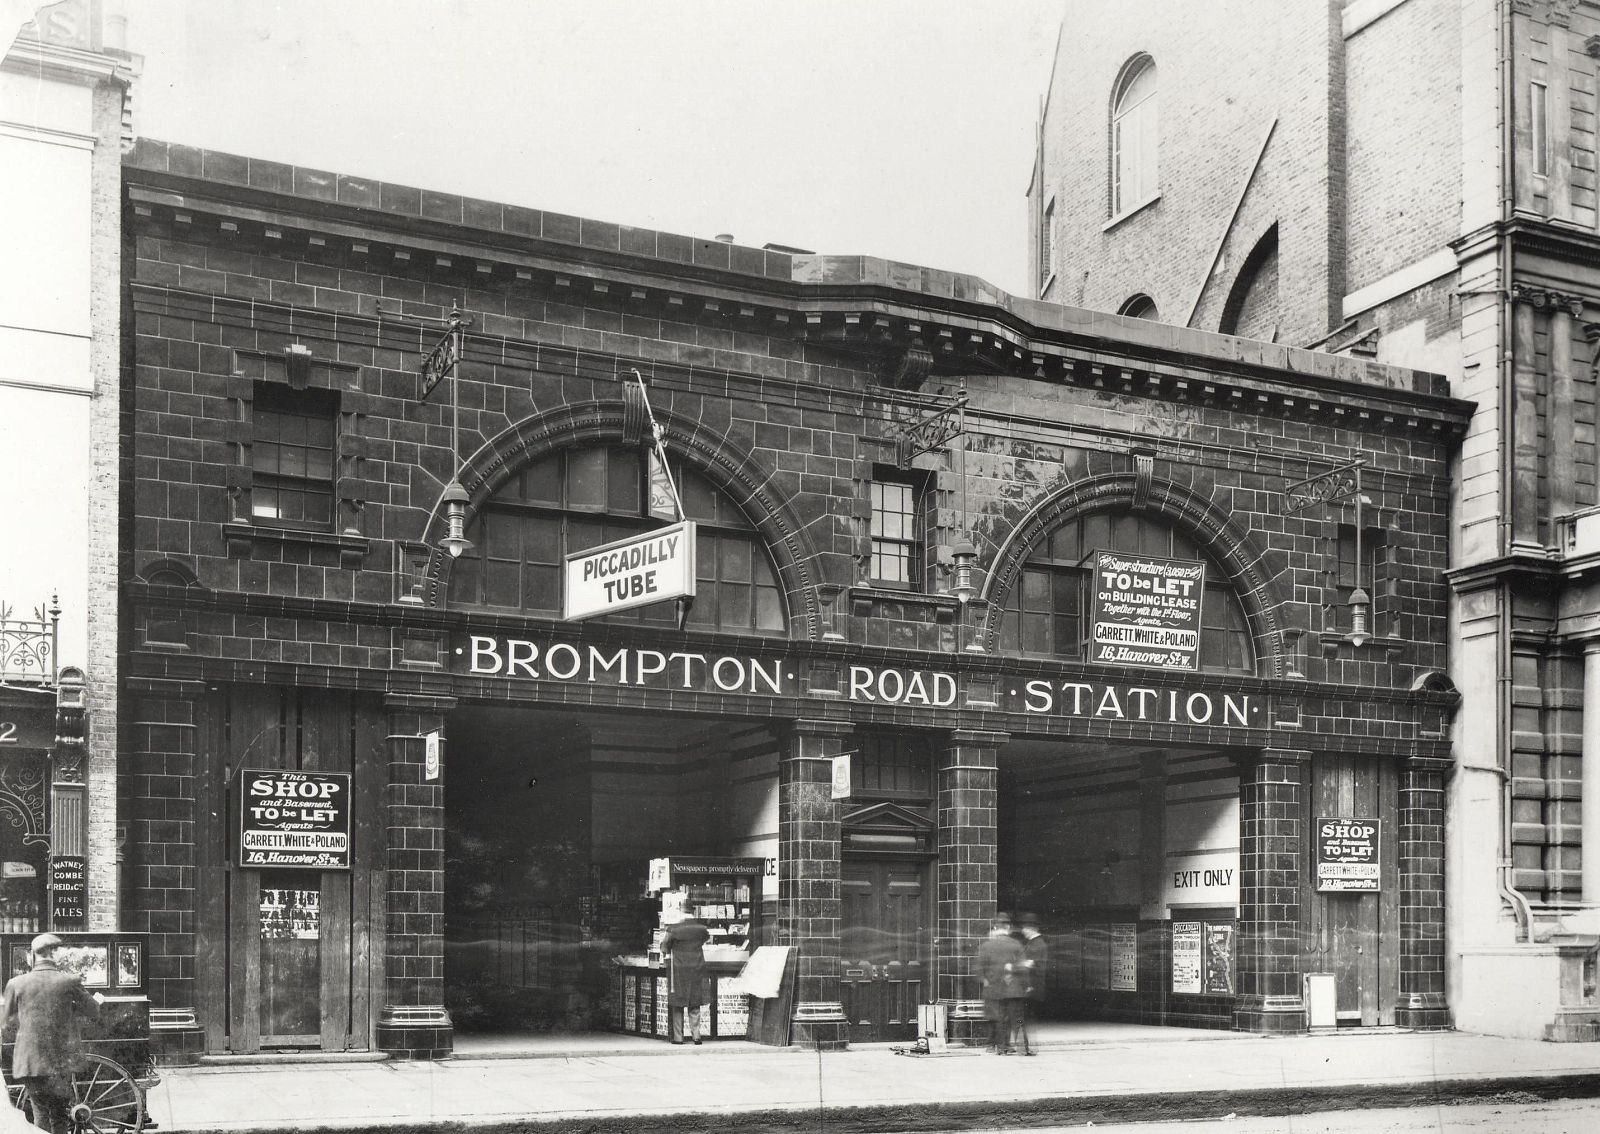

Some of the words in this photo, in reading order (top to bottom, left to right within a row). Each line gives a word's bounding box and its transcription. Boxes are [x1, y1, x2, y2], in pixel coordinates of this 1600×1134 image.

[584, 536, 678, 582] PICCADILLY
[604, 570, 658, 603] TUBE
[1102, 572, 1132, 590] TO
[1133, 576, 1150, 589] be
[1152, 577, 1194, 596] LET
[1098, 592, 1112, 601] on
[1112, 591, 1160, 605] BUILDING
[1162, 597, 1197, 610] LEASE
[1102, 603, 1136, 614] Together
[1136, 606, 1150, 616] with
[1151, 607, 1162, 617] the
[1134, 628, 1160, 644] WHITE
[1164, 632, 1196, 648] POLAND
[1098, 646, 1115, 662] 16,
[1114, 646, 1168, 664] Hanover
[470, 635, 782, 694] BROMPTON
[848, 666, 958, 706] ROAD
[1025, 680, 1250, 726] STATION
[250, 780, 340, 798] SHOP
[284, 799, 333, 809] Basement,
[250, 808, 280, 820] TO
[282, 808, 297, 817] be
[301, 810, 338, 822] LET
[275, 822, 314, 831] Agents
[1322, 824, 1375, 838] SHOP
[284, 834, 310, 847] WHITE
[316, 834, 346, 848] POLAND
[246, 852, 267, 864] 16,
[266, 852, 317, 864] Hanover
[1324, 846, 1342, 855] TO
[1351, 846, 1374, 856] LET
[673, 864, 707, 873] Newspapers
[708, 865, 734, 874] promptly
[1174, 870, 1200, 888] EXIT
[1204, 868, 1233, 887] ONLY
[54, 908, 83, 917] ALES
